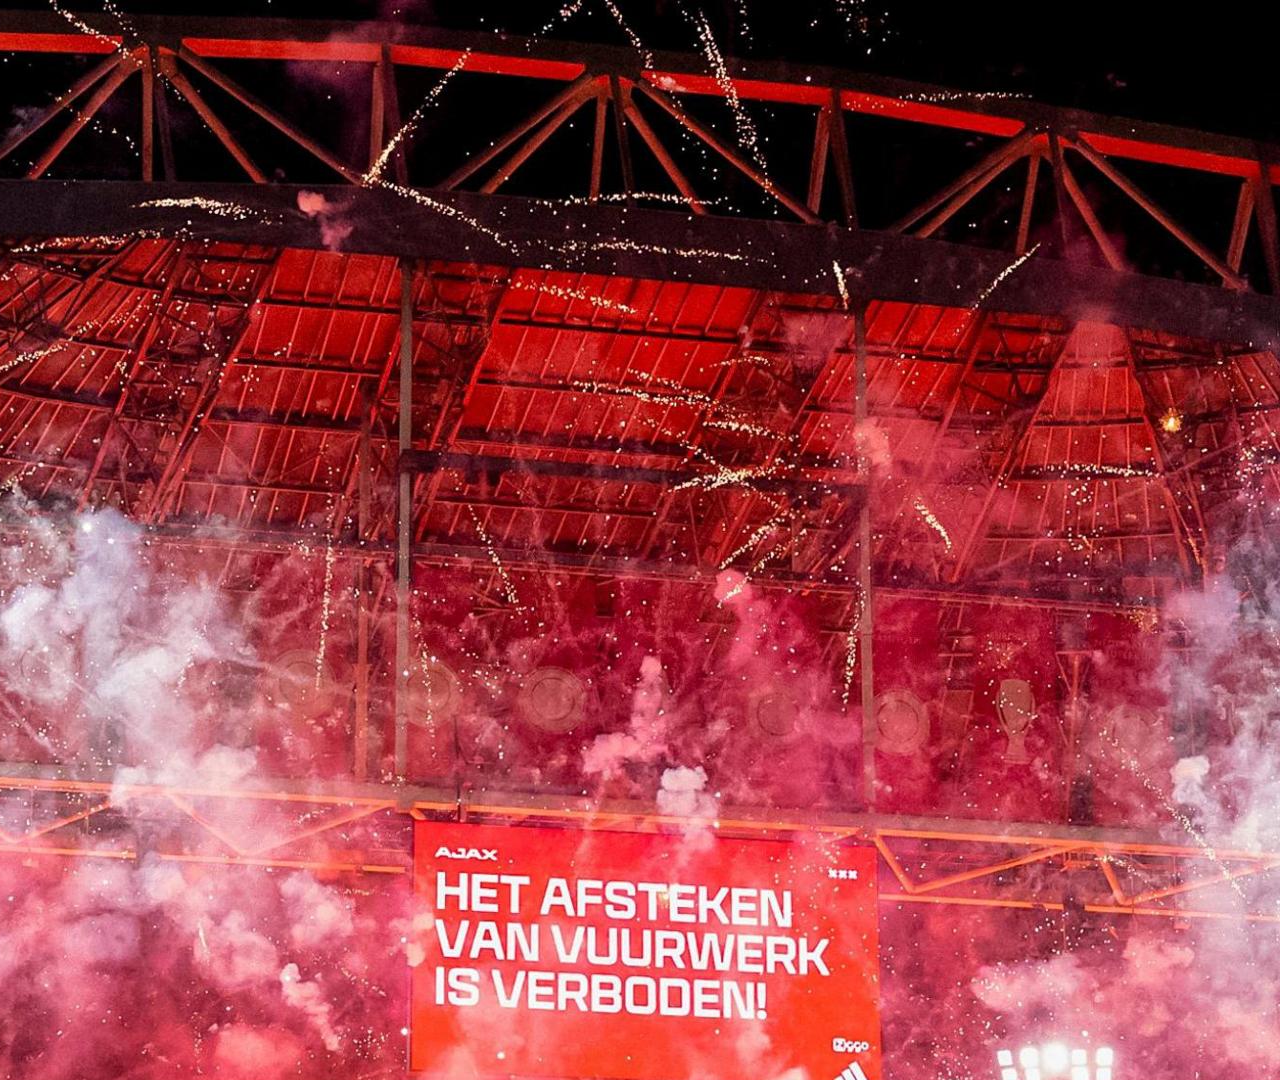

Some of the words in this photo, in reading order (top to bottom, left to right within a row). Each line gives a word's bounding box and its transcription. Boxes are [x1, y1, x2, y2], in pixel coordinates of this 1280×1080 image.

[435, 846, 498, 861] AJAX
[436, 871, 530, 914] HET
[540, 877, 792, 928] AFSTEKEN
[435, 919, 540, 962] VAN
[550, 925, 830, 976] VUURWERK
[435, 967, 480, 1006] IS
[491, 969, 768, 1021] VERBODEN!
